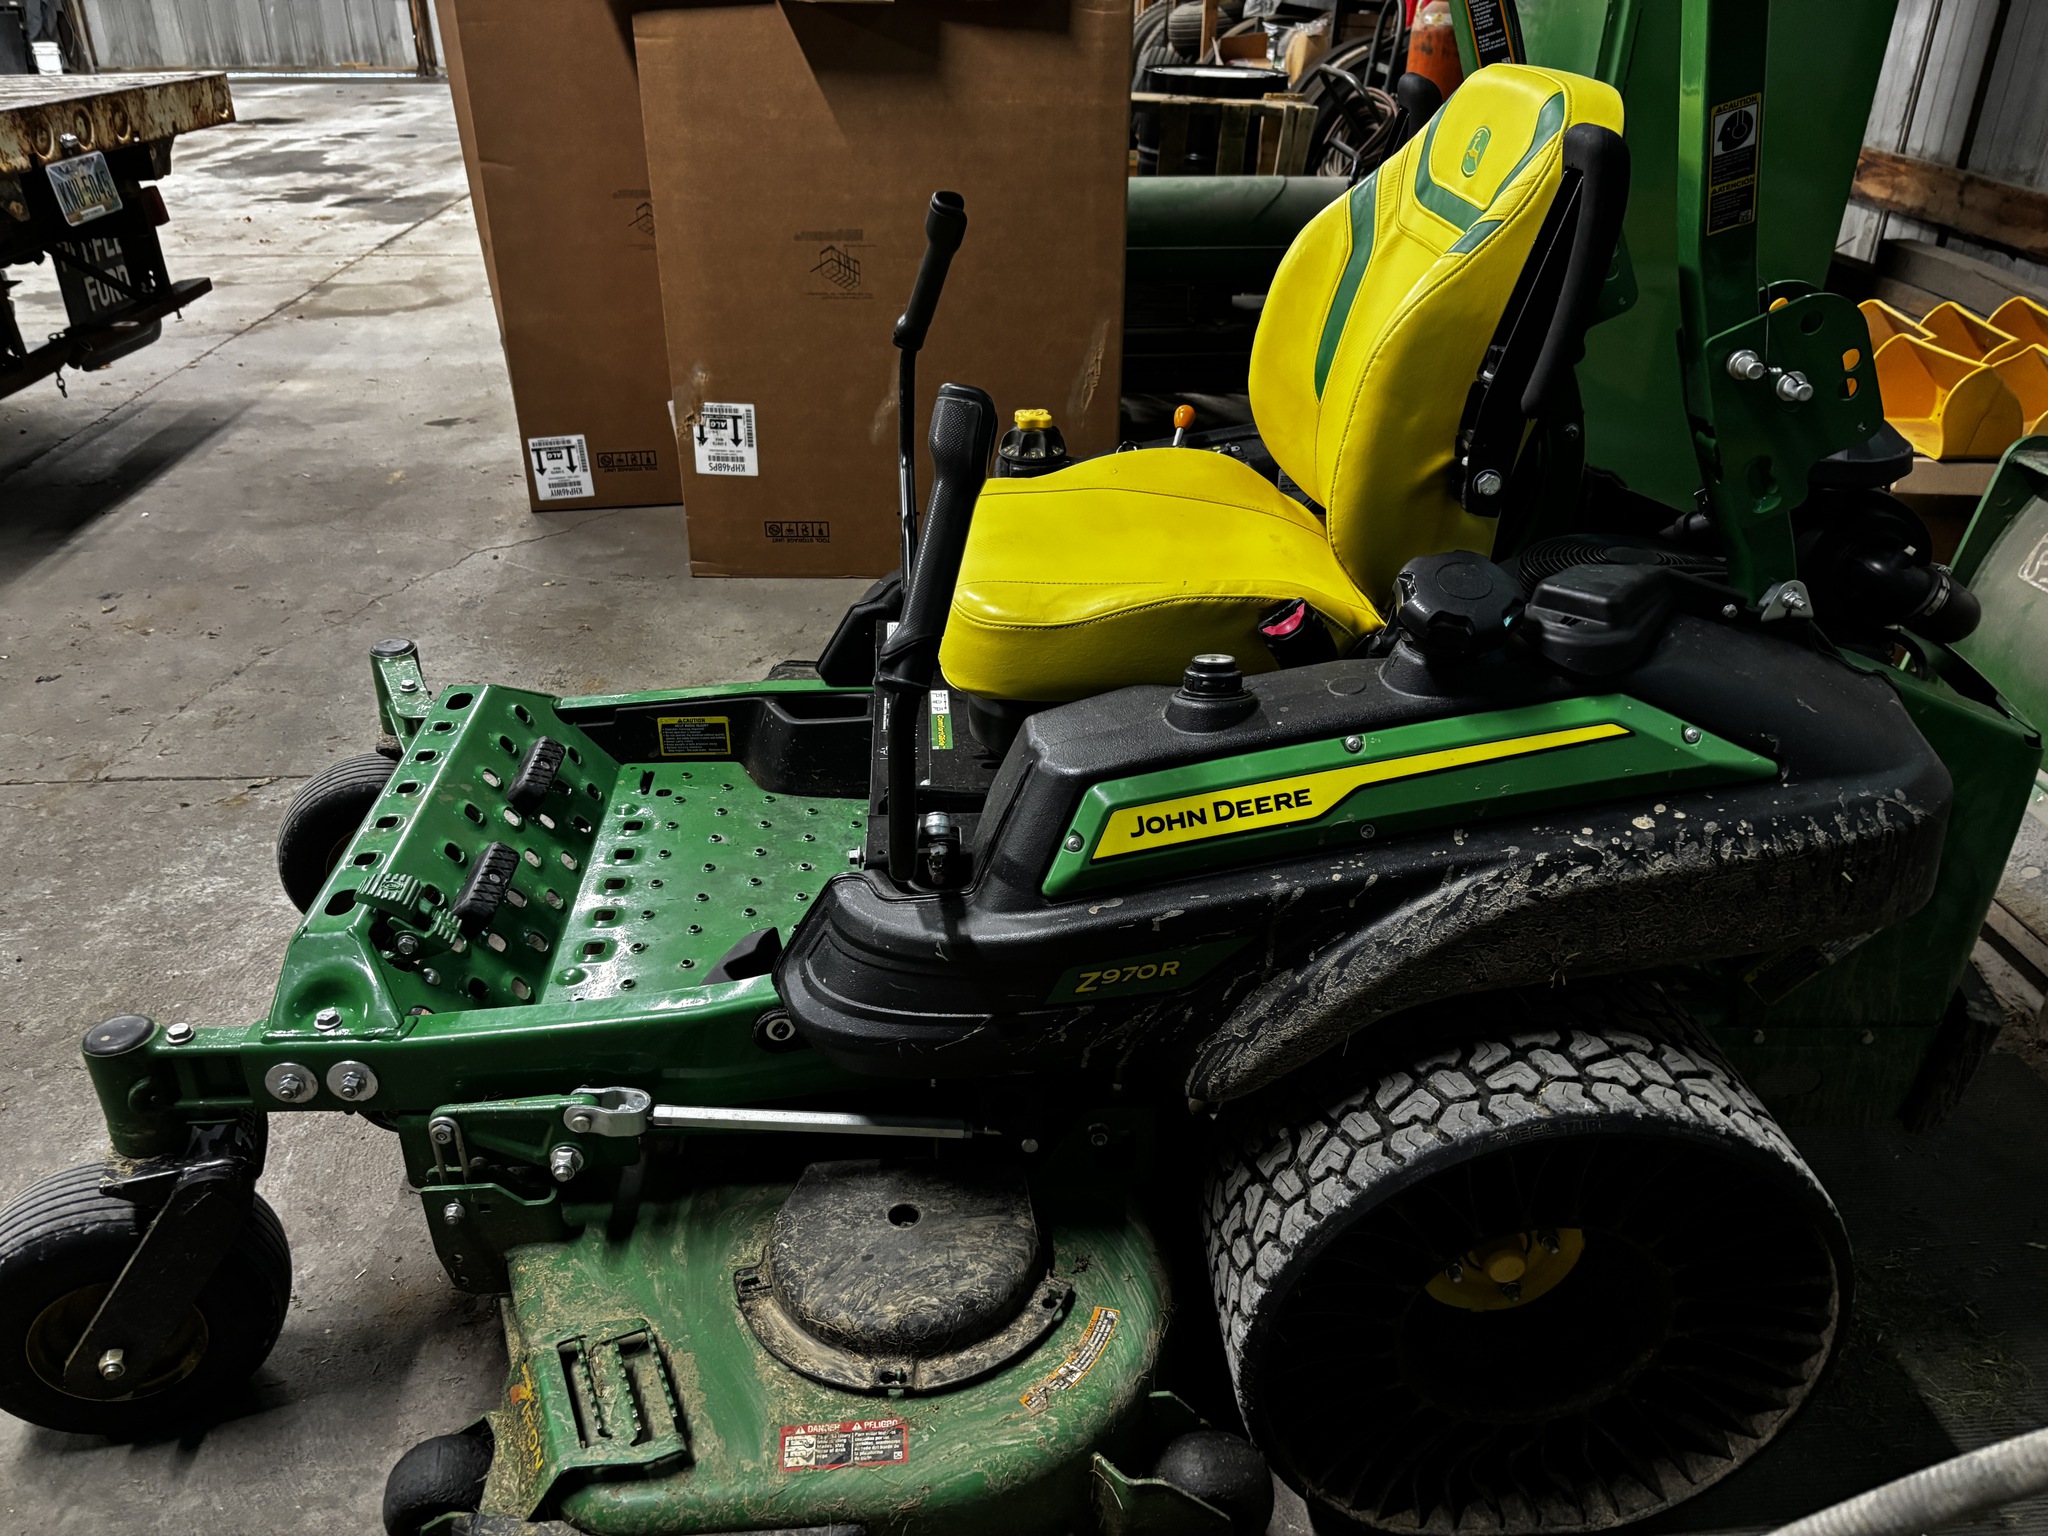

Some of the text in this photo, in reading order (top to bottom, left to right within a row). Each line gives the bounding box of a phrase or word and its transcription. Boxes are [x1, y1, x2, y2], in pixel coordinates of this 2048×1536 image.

[1723, 94, 1758, 111] CAUTION
[58, 170, 114, 214] KNU 5045
[1717, 176, 1755, 193] ATENCIÓN
[708, 462, 746, 473] KHP46BPS
[1130, 788, 1313, 838] JOHN DEERE
[1074, 960, 1180, 994] Z970R
[864, 1419, 898, 1430] PELIGRO
